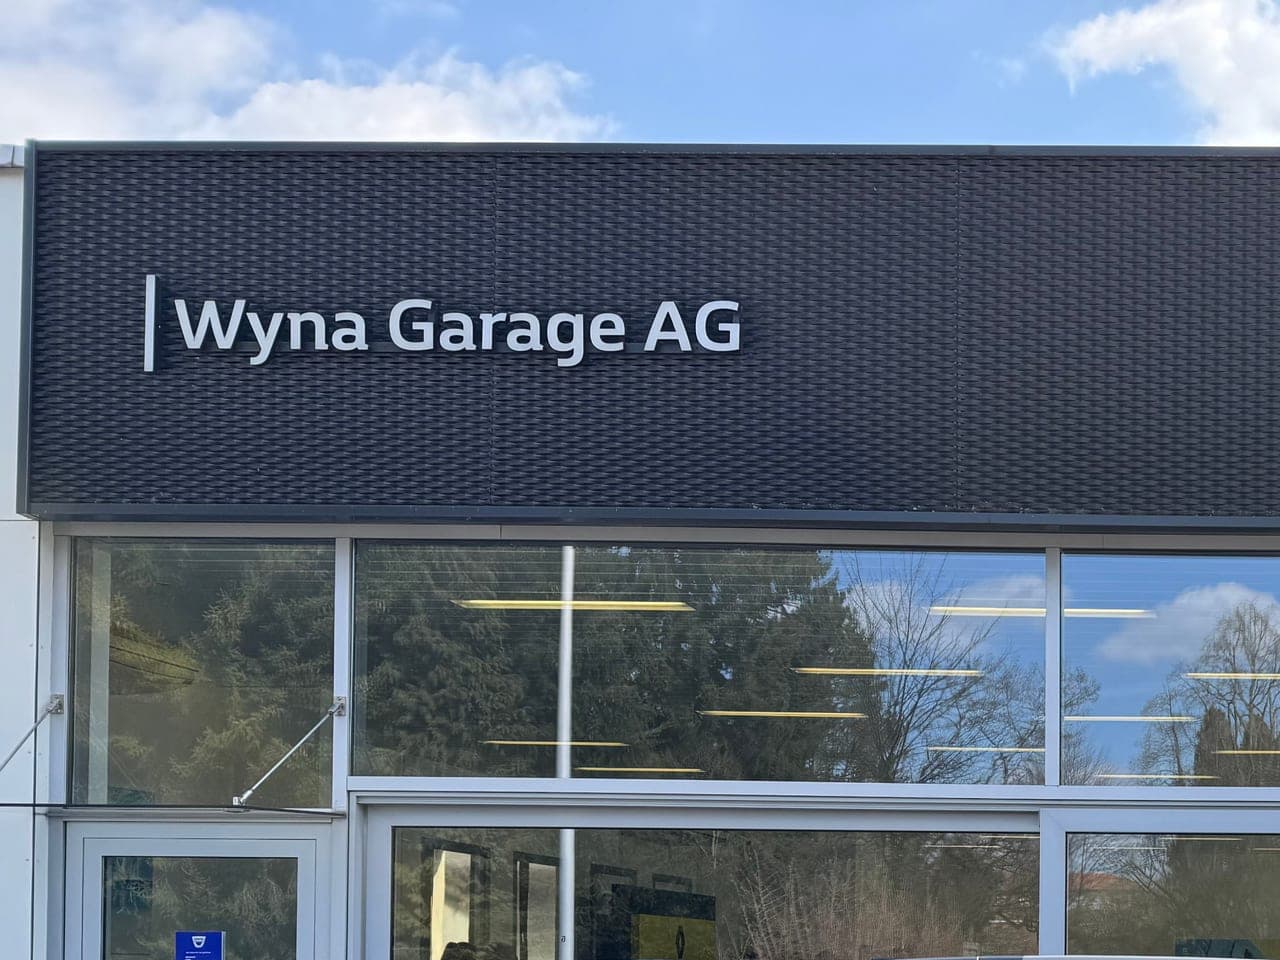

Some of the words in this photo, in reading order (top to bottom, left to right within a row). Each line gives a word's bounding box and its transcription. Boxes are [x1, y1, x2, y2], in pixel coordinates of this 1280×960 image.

[175, 300, 368, 365] Wyna
[390, 299, 625, 366] Garage
[644, 301, 740, 351] AG
